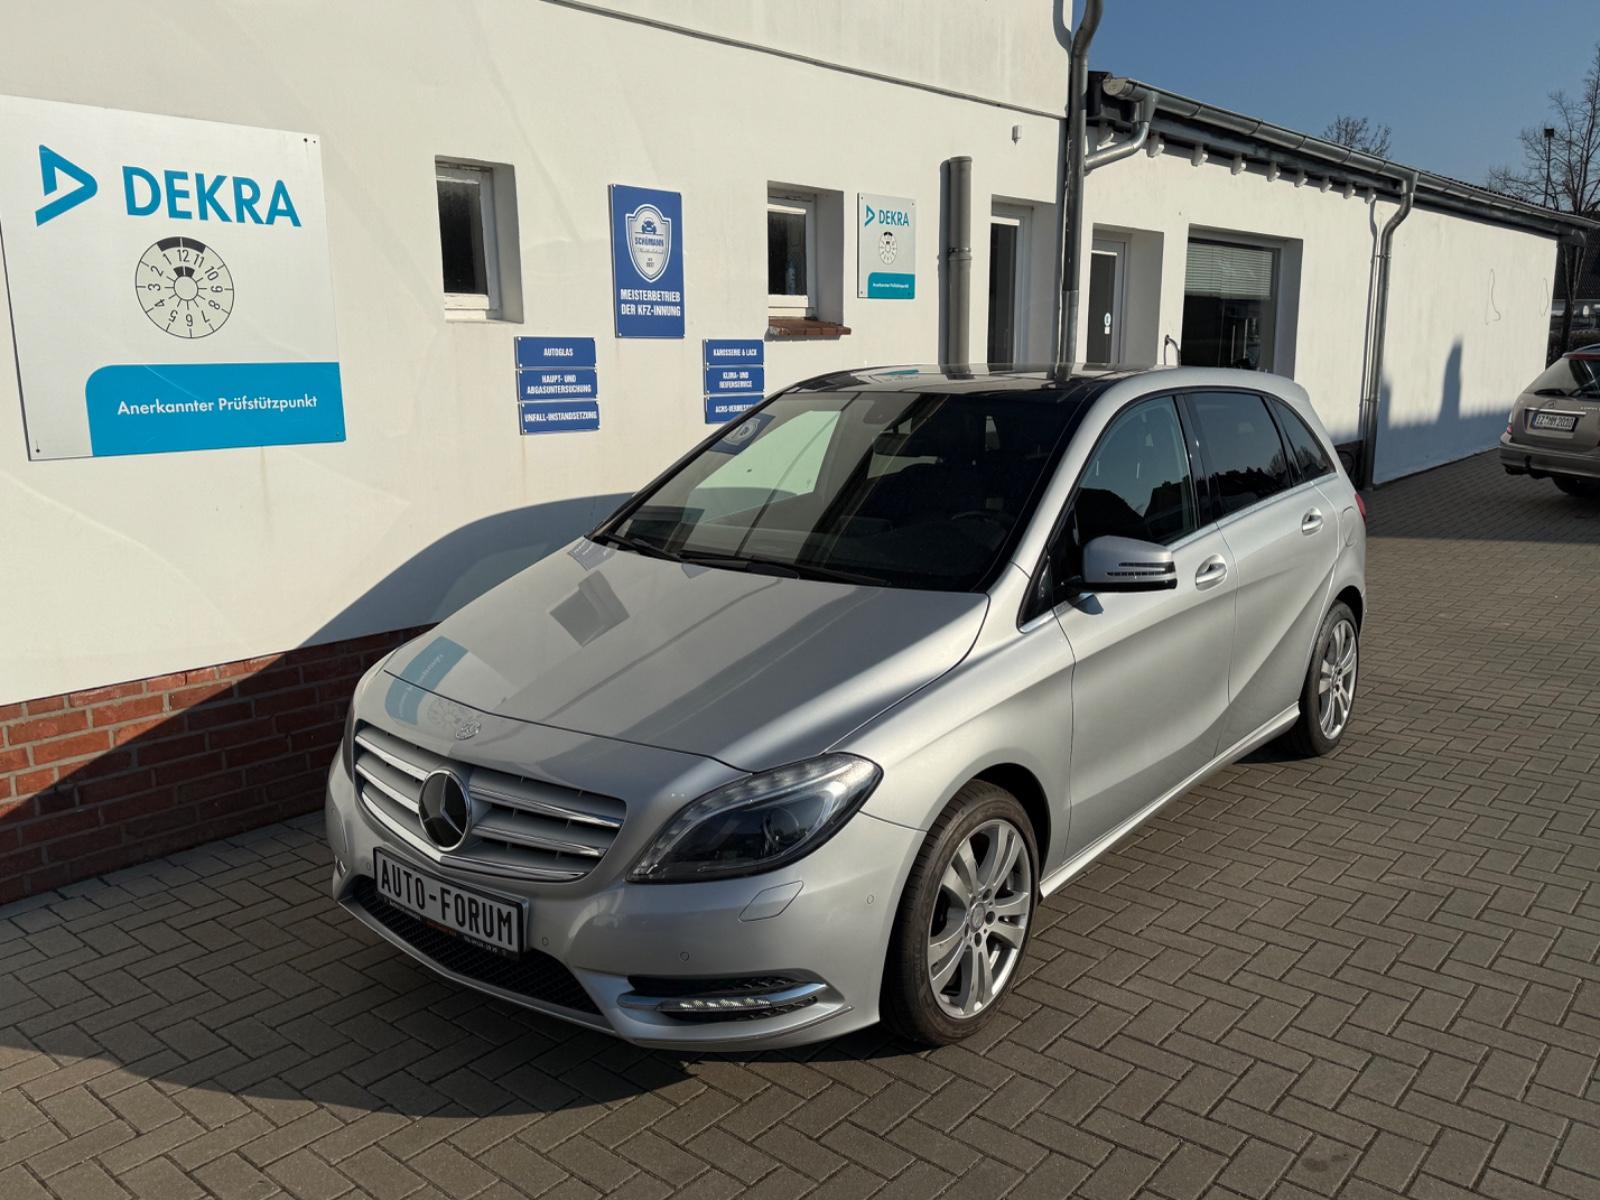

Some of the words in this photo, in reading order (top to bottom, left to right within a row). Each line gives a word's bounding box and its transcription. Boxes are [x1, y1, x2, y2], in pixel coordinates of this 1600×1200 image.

[122, 165, 302, 227] DEKRA
[879, 209, 910, 226] DEKRA
[163, 253, 172, 265] 1
[177, 249, 190, 262] 12
[194, 253, 205, 268] 11
[150, 265, 164, 277] 2
[205, 266, 219, 281] 10
[147, 283, 161, 291] 3
[210, 285, 223, 293] 9
[620, 288, 681, 302] MEISTERBETRIEB
[154, 299, 165, 307] 4
[208, 299, 220, 310] 8
[168, 309, 178, 323] 5
[201, 310, 210, 323] 7
[621, 303, 636, 315] DER
[637, 304, 681, 317] KFZ-INNUNG
[185, 313, 194, 327] 6
[543, 347, 574, 357] AUTOGLAS
[541, 374, 563, 383] HAUPT-
[564, 374, 577, 383] UND
[117, 399, 214, 415] Anerkannter
[218, 395, 318, 414] Prüfstützpunkt
[524, 410, 598, 423] UNFALL-INSTANDSETZUNG
[381, 859, 514, 946] AUTO-FORUM
